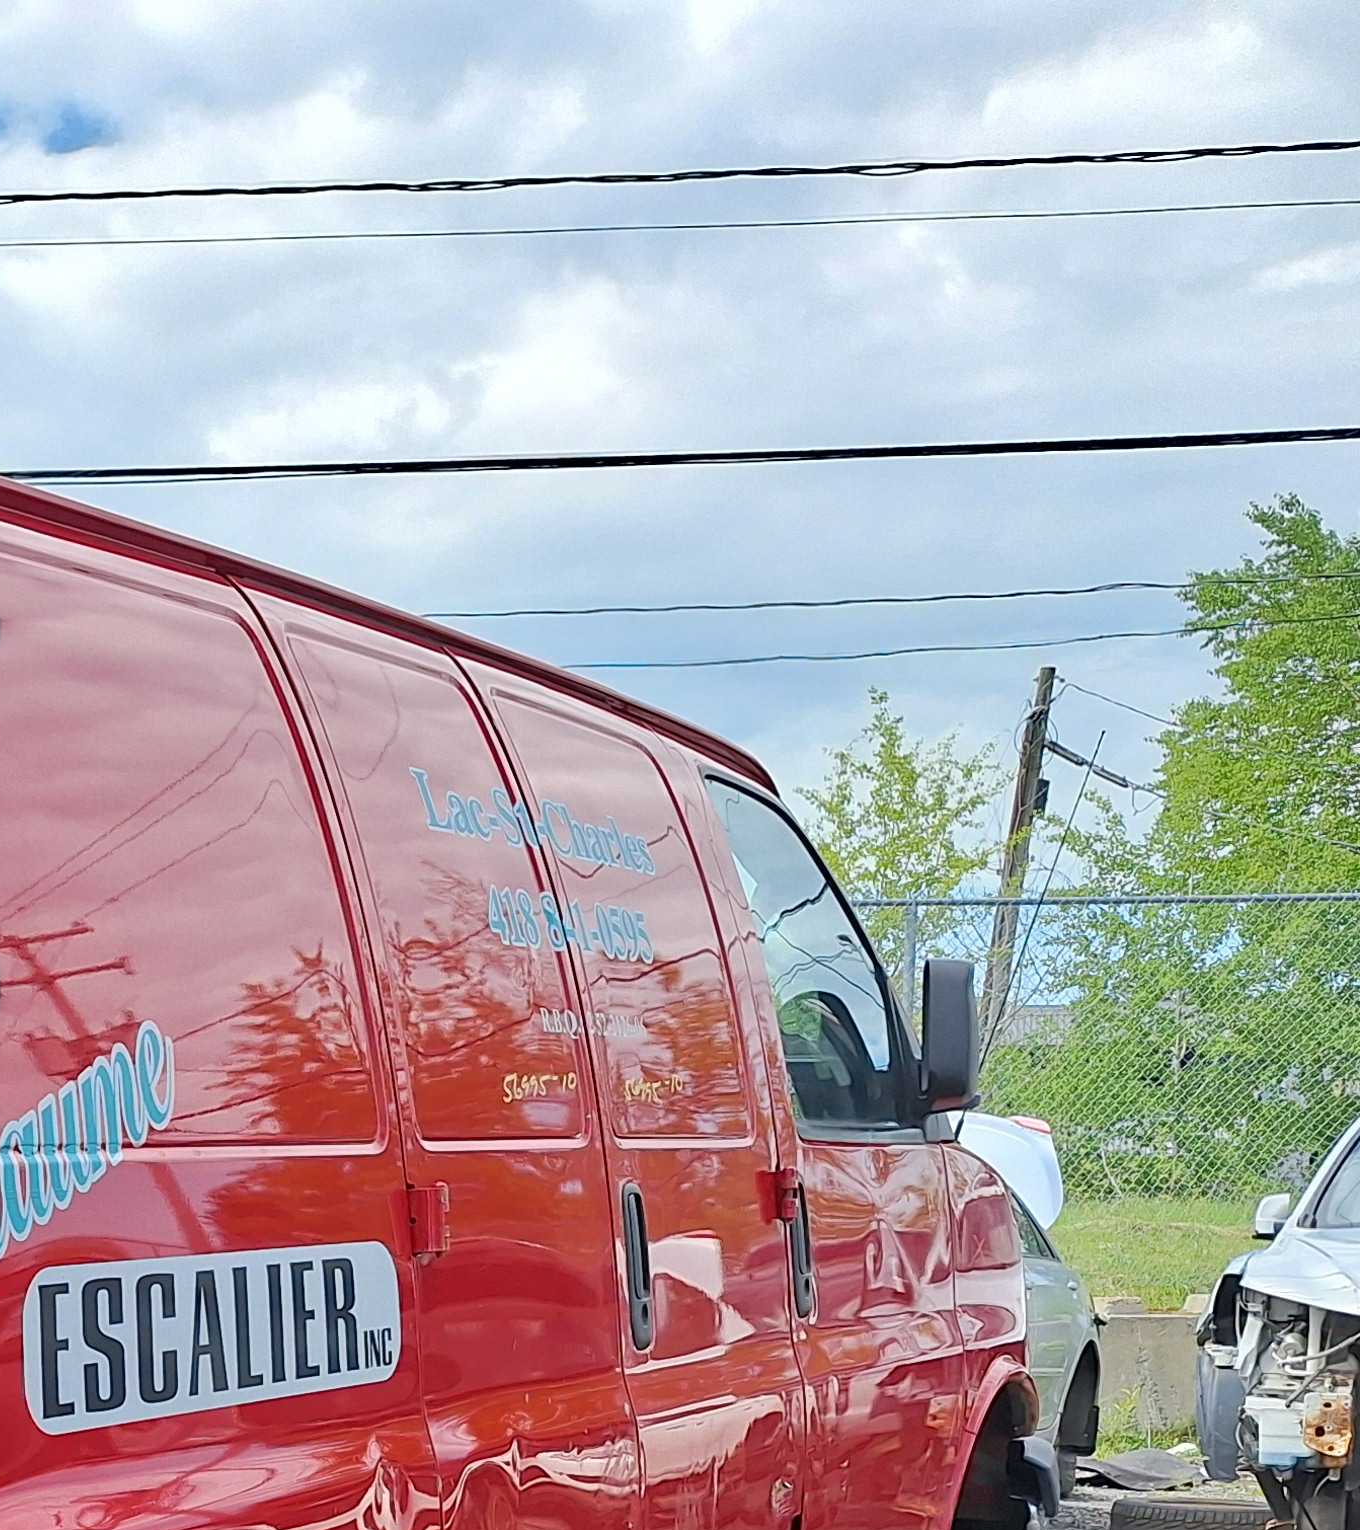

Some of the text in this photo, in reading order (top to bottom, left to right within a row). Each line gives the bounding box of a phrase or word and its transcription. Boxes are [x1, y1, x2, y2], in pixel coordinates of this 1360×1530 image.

[408, 766, 656, 876] Lac-St-Charles
[488, 884, 655, 965] 418 841-0595
[37, 1257, 394, 1420] ESCALIER INC
